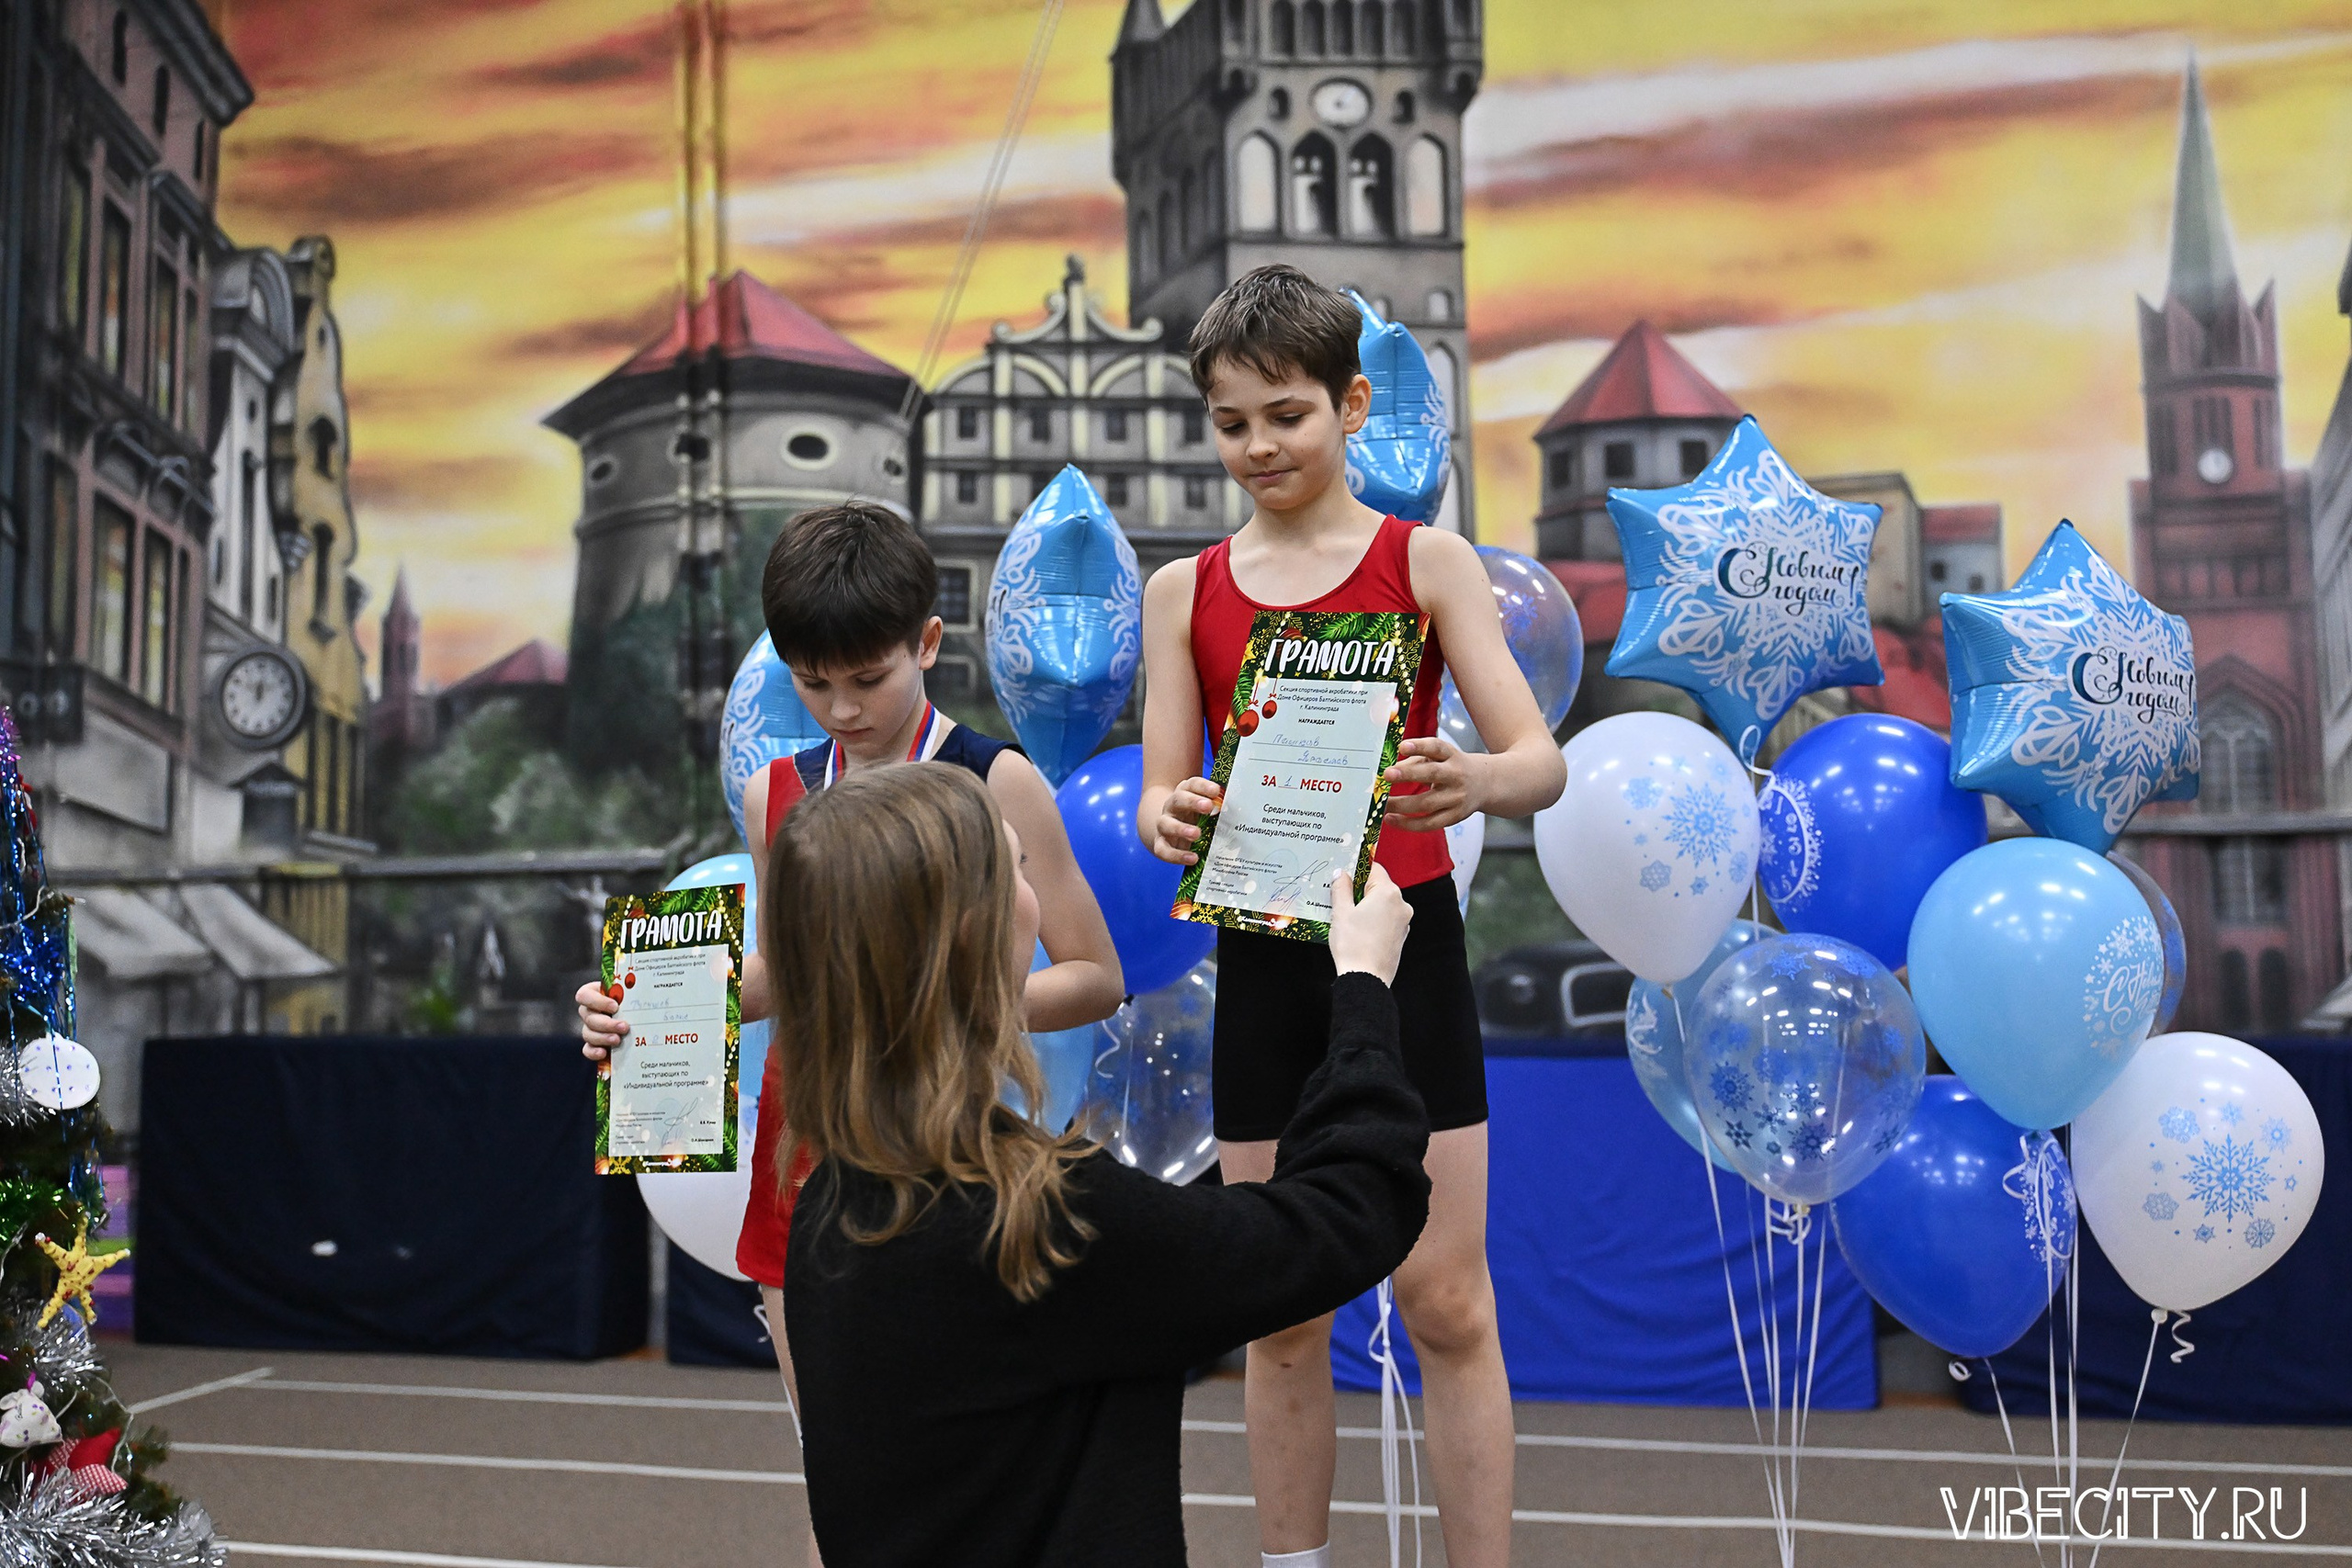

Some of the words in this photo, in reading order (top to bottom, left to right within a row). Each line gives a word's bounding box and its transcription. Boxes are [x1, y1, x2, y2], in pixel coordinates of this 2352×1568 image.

[1264, 638, 1397, 676] ГРАМОТА
[1319, 695, 1350, 704] Балтийского
[1261, 774, 1276, 787] ЗА
[1300, 778, 1342, 793] МЕСТО
[1262, 804, 1286, 818] Среди
[1287, 808, 1327, 819] мальчиков,
[1261, 817, 1311, 829] выступающих
[1235, 824, 1300, 840] «Индивидуальной
[1300, 831, 1344, 844] программе»
[620, 909, 722, 949] ГРАМОТА
[635, 1036, 647, 1047] ЗА
[664, 1032, 698, 1045] МЕСТО
[640, 1061, 658, 1069] Среди
[641, 1069, 680, 1078] выступающих
